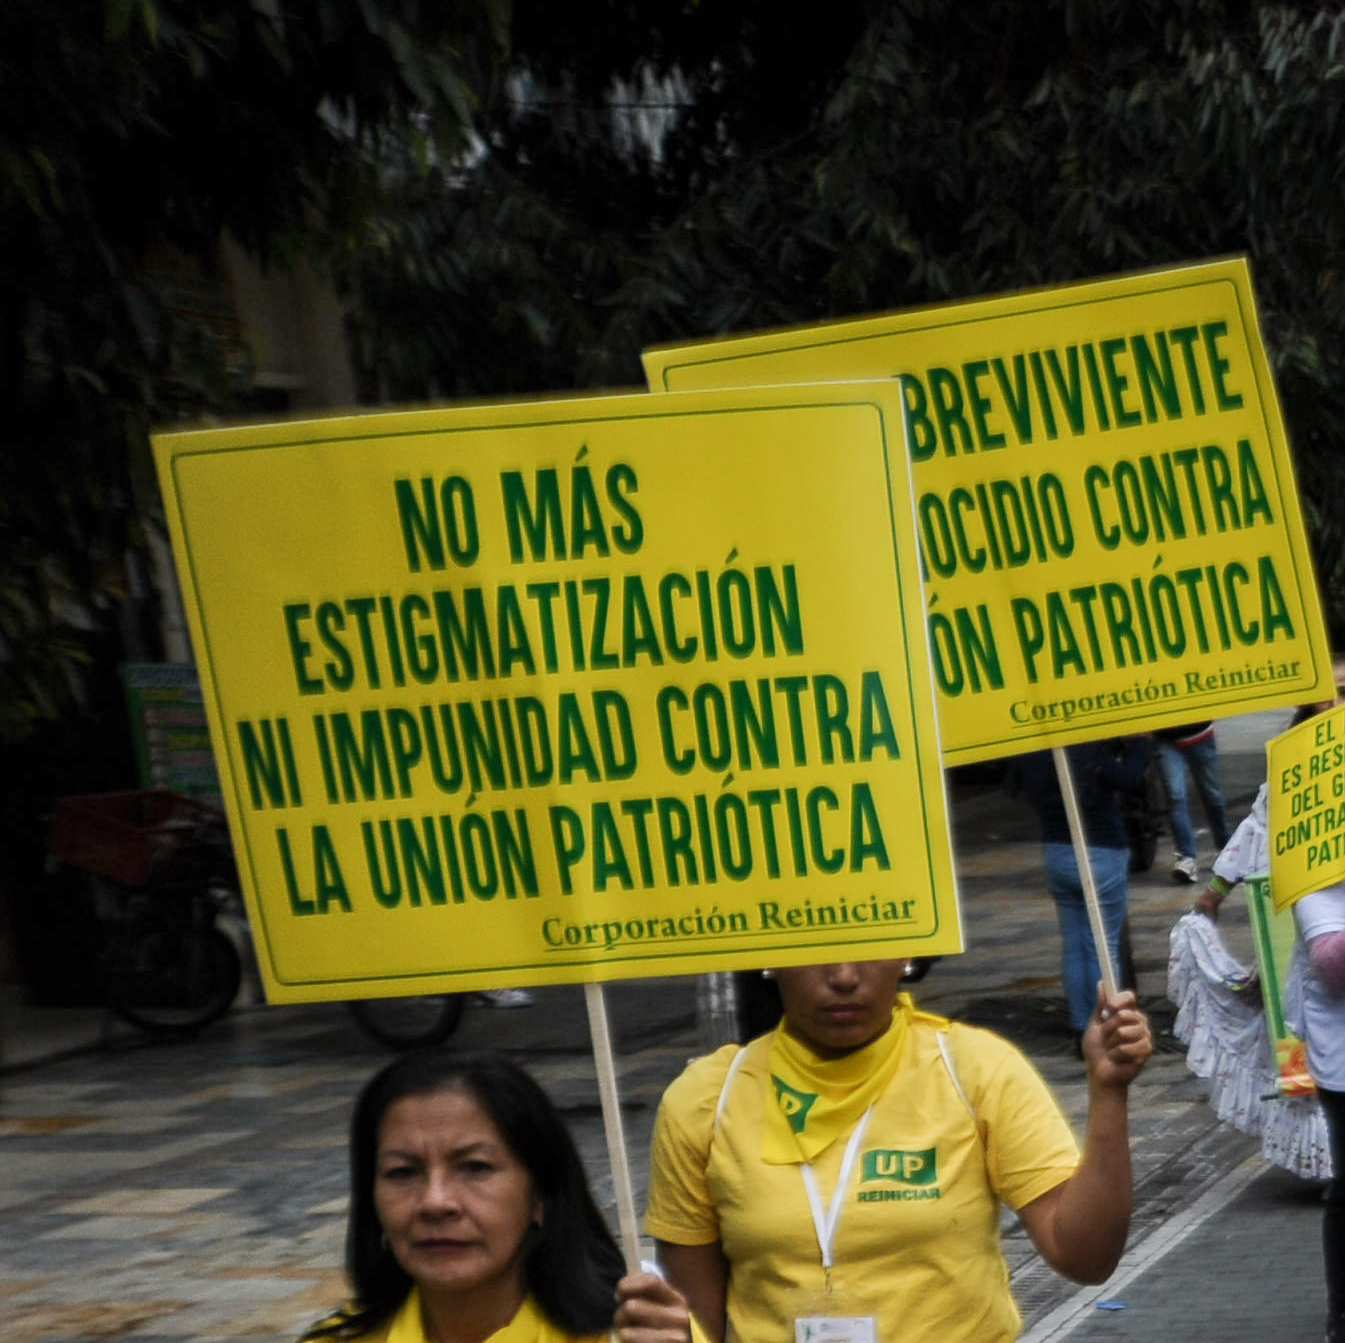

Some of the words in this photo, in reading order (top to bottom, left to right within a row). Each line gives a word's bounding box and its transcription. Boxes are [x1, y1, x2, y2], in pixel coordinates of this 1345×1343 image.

[395, 475, 479, 573] NO
[500, 445, 644, 564] MÁS
[917, 471, 1076, 583] OCIDIO
[1084, 438, 1274, 550] CONTRA
[283, 548, 803, 696] ESTIGMATIZACIÓN
[1010, 555, 1295, 684] PATRIÓTICA
[1009, 678, 1177, 725] Corporación
[1185, 661, 1301, 693] Reiniciar
[237, 717, 302, 811] NI
[314, 688, 638, 806] IMPUNIDAD
[656, 671, 901, 776] CONTRA
[1315, 722, 1338, 747] EL
[1281, 764, 1302, 794] ES
[1291, 789, 1324, 818] DEL
[275, 825, 353, 916] LA
[362, 793, 538, 910] UNIÓN
[549, 775, 891, 895] PATRIÓTICA
[542, 906, 749, 950] Corporación
[759, 894, 916, 932] Reiniciar
[858, 1187, 941, 1203] REINICIAR
[875, 1154, 924, 1180] UP
